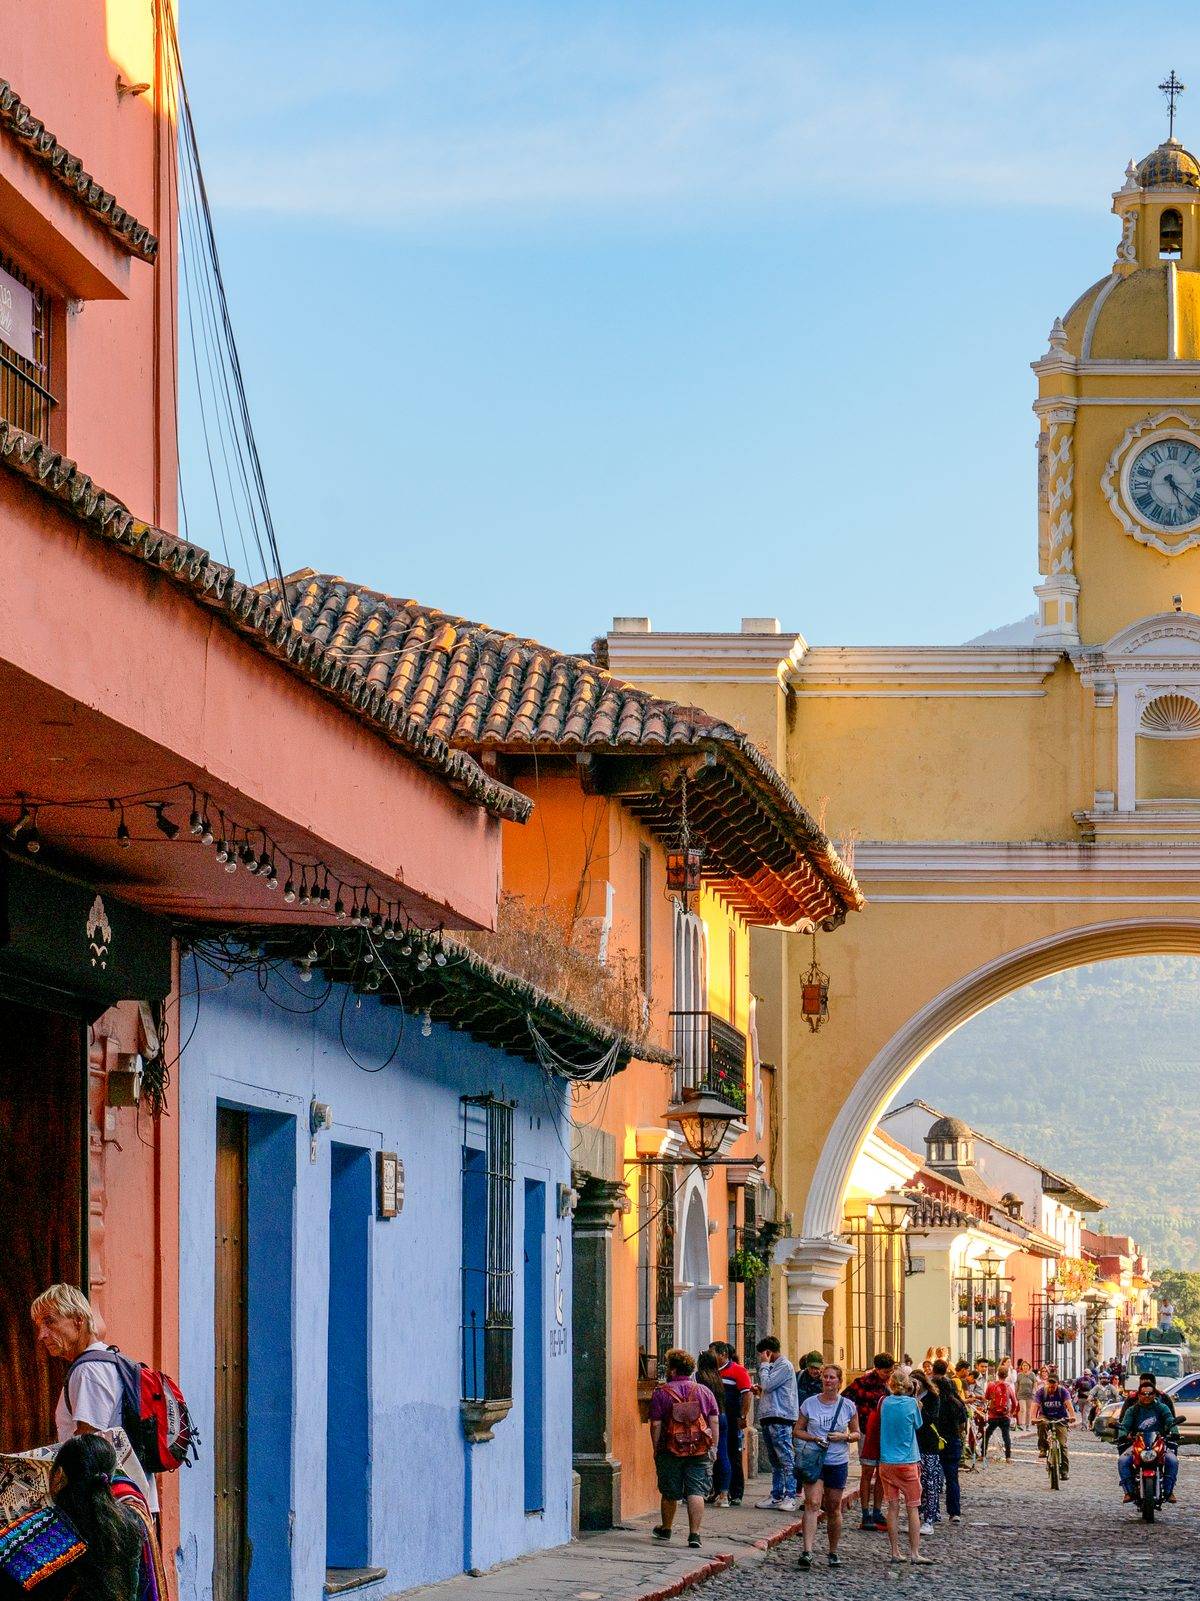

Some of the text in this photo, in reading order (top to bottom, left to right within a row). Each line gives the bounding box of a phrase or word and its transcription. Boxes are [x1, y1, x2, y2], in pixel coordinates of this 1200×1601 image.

[1151, 450, 1163, 464] XI
[1167, 446, 1179, 460] XII
[1182, 450, 1193, 464] I
[1134, 480, 1151, 490] IX
